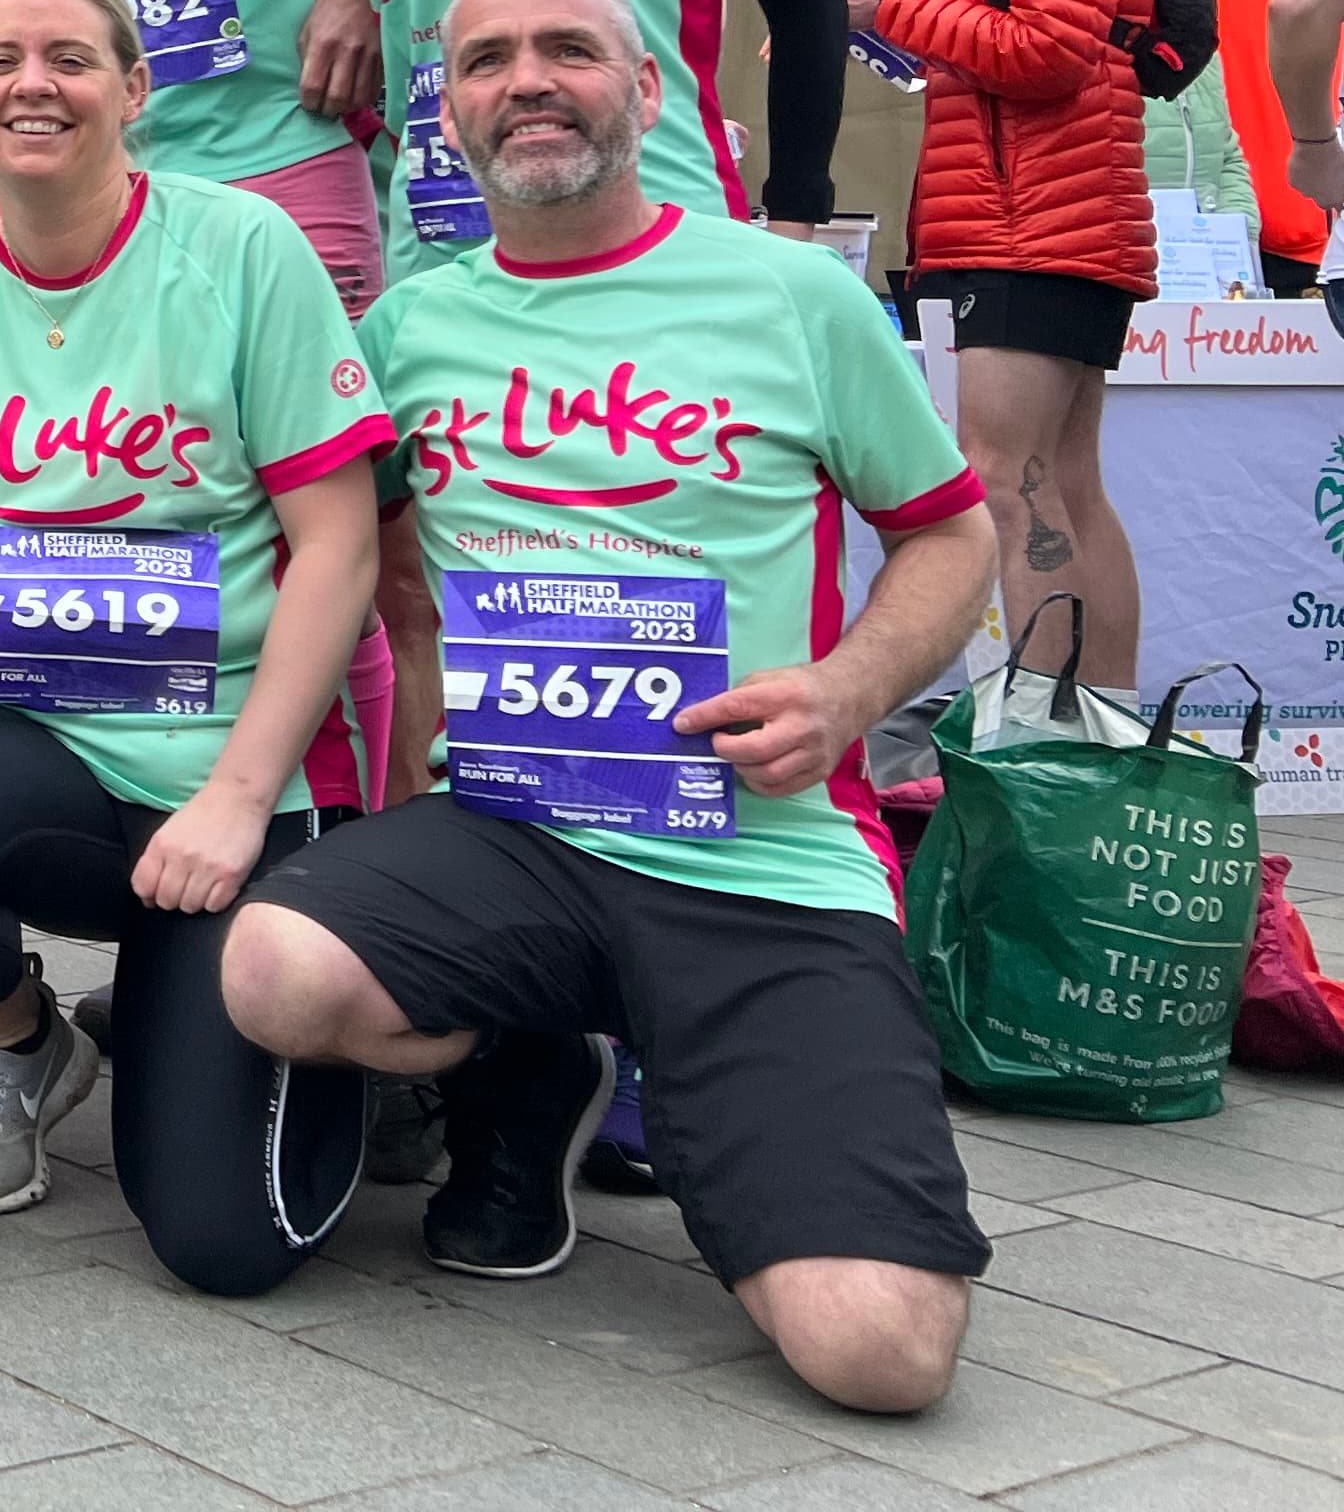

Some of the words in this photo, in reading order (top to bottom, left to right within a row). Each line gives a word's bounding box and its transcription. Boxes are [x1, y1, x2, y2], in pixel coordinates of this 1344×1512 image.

[1184, 305, 1319, 373] freedom
[503, 361, 763, 482] Luke's
[45, 546, 86, 557] HALF
[90, 546, 189, 561] MARATHON
[47, 534, 123, 546] SHEFFIELD
[456, 528, 578, 557] Sheffield's
[589, 531, 704, 560] Hospice
[134, 559, 192, 577] 2023
[527, 581, 616, 600] SHEFFIELD
[12, 588, 180, 636] 5619
[527, 599, 575, 615] HALF
[579, 601, 693, 619] MARATHON
[629, 620, 697, 642] 2023
[1, 672, 24, 682] FOR
[26, 674, 48, 683] ALL
[498, 662, 683, 721] 5679
[155, 697, 208, 714] 5619
[458, 769, 487, 781] RUN
[489, 771, 516, 784] FOR
[518, 773, 542, 786] ALL
[667, 809, 727, 829] 5679
[1125, 804, 1213, 847] THIS
[1222, 822, 1247, 849] IS
[1091, 835, 1177, 878] NOT
[1127, 882, 1224, 923] FOOD
[1104, 948, 1189, 990] THIS
[1198, 965, 1222, 991] IS
[1057, 975, 1144, 1020] M&S
[1159, 999, 1228, 1026] FOOD
[986, 1016, 1015, 1037] This
[1022, 1028, 1051, 1050] bag
[1058, 1038, 1070, 1053] is
[1077, 1045, 1117, 1065] made
[1076, 1063, 1128, 1087] turning
